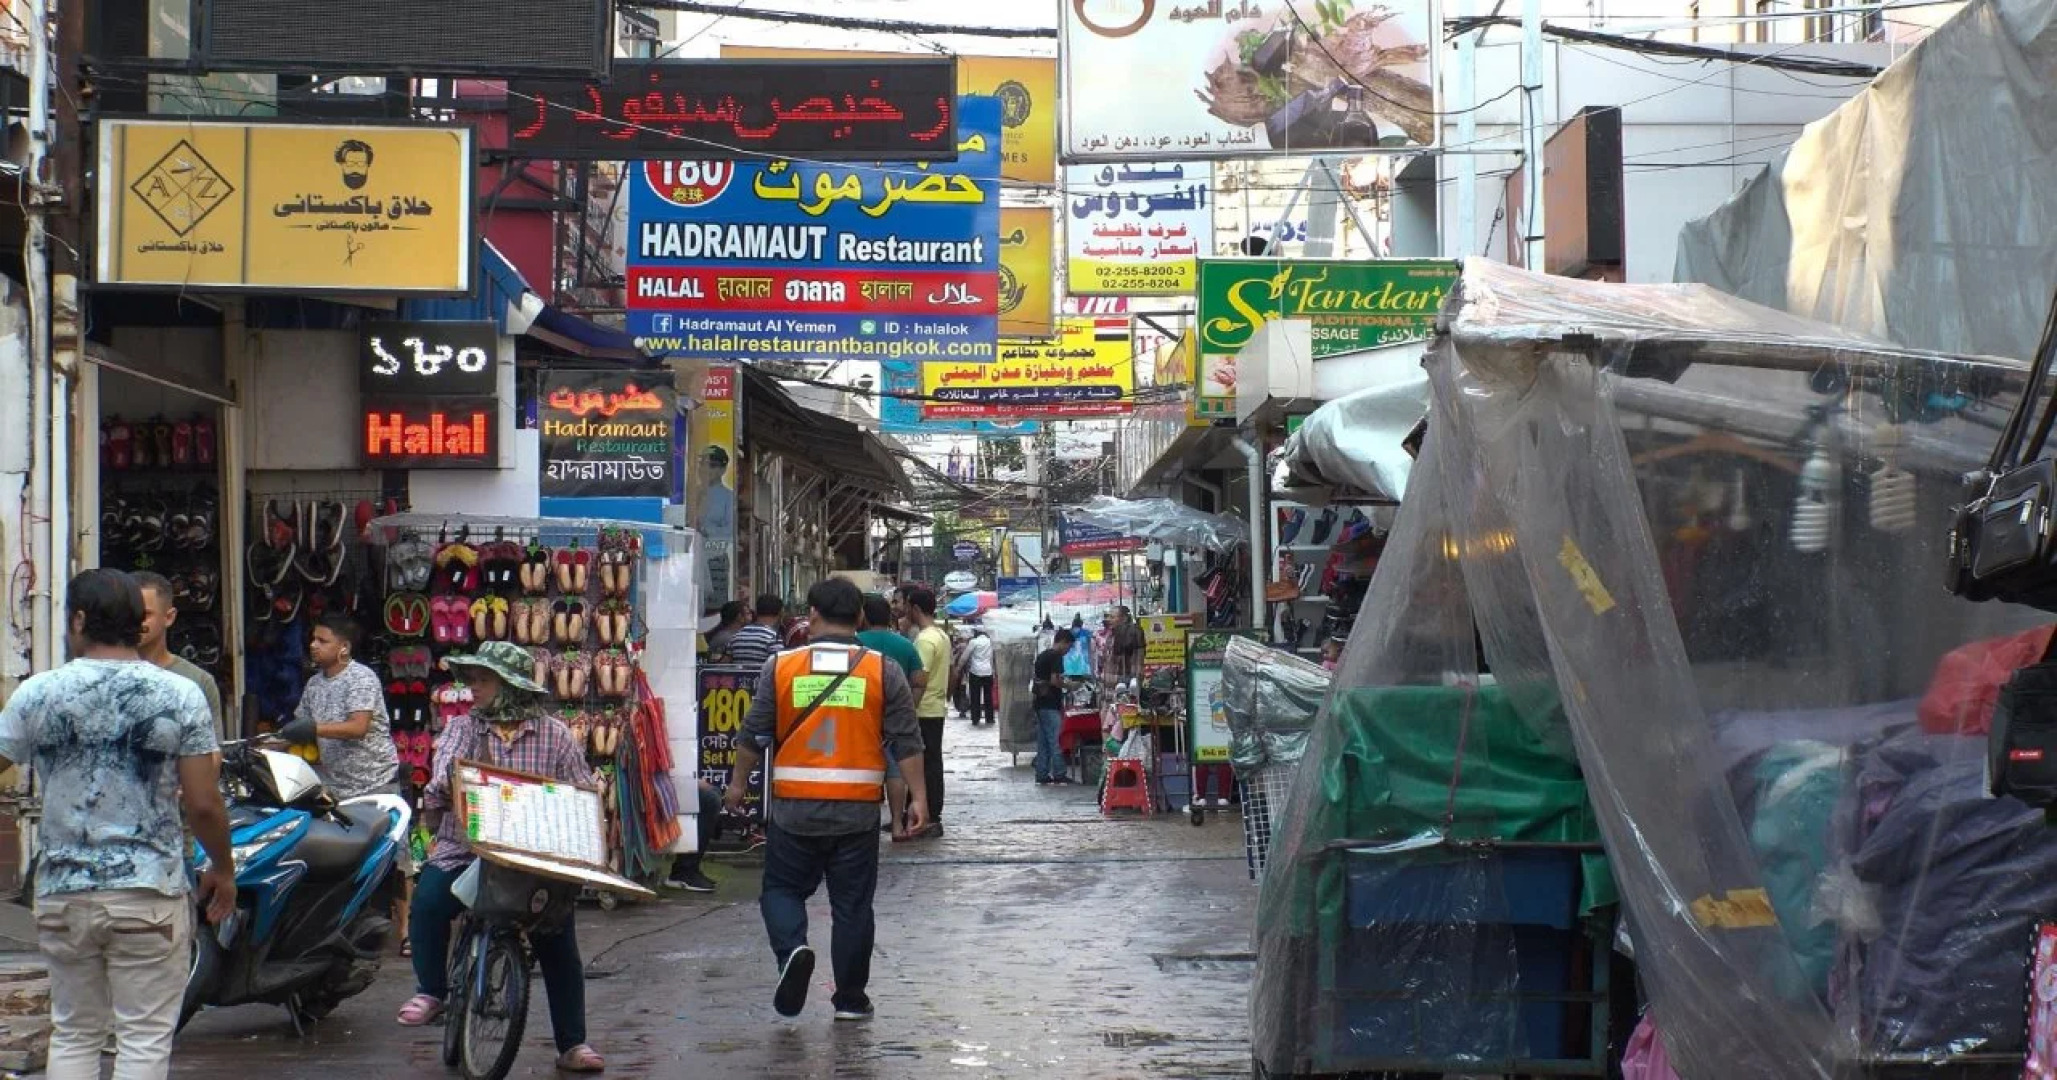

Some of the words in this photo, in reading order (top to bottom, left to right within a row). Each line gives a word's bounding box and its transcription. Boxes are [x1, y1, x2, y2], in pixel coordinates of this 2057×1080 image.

[146, 175, 171, 198] A
[195, 175, 219, 199] Z
[386, 193, 434, 221] حلاق
[1072, 183, 1206, 219] الفردوس
[641, 221, 827, 260] HADRAMAUT
[838, 231, 984, 264] Restaurant
[1149, 222, 1187, 240] غرف
[1150, 237, 1198, 259] أسعار
[1095, 266, 1186, 277] 02-255-8200-3
[637, 276, 705, 298] HALAL
[717, 276, 774, 302] हालाल
[784, 278, 846, 302] ฮาลาล
[927, 281, 983, 305] حلال
[679, 317, 763, 332] Hadramaut
[766, 317, 781, 332] Al
[785, 319, 837, 334] Yemen
[884, 321, 900, 334] ID
[914, 322, 969, 336] halalok
[1294, 315, 1416, 326] ADITIONAL
[1312, 327, 1360, 341] SSAGE
[370, 335, 488, 376] ১৮০
[643, 334, 993, 359] ww.halalrestaurantbangkok.com
[366, 412, 488, 455] Halal
[544, 419, 667, 437] Hadramaut
[576, 439, 667, 453] Restaurant
[702, 688, 751, 732] 180
[806, 717, 836, 757] 4
[703, 750, 724, 765] Set
